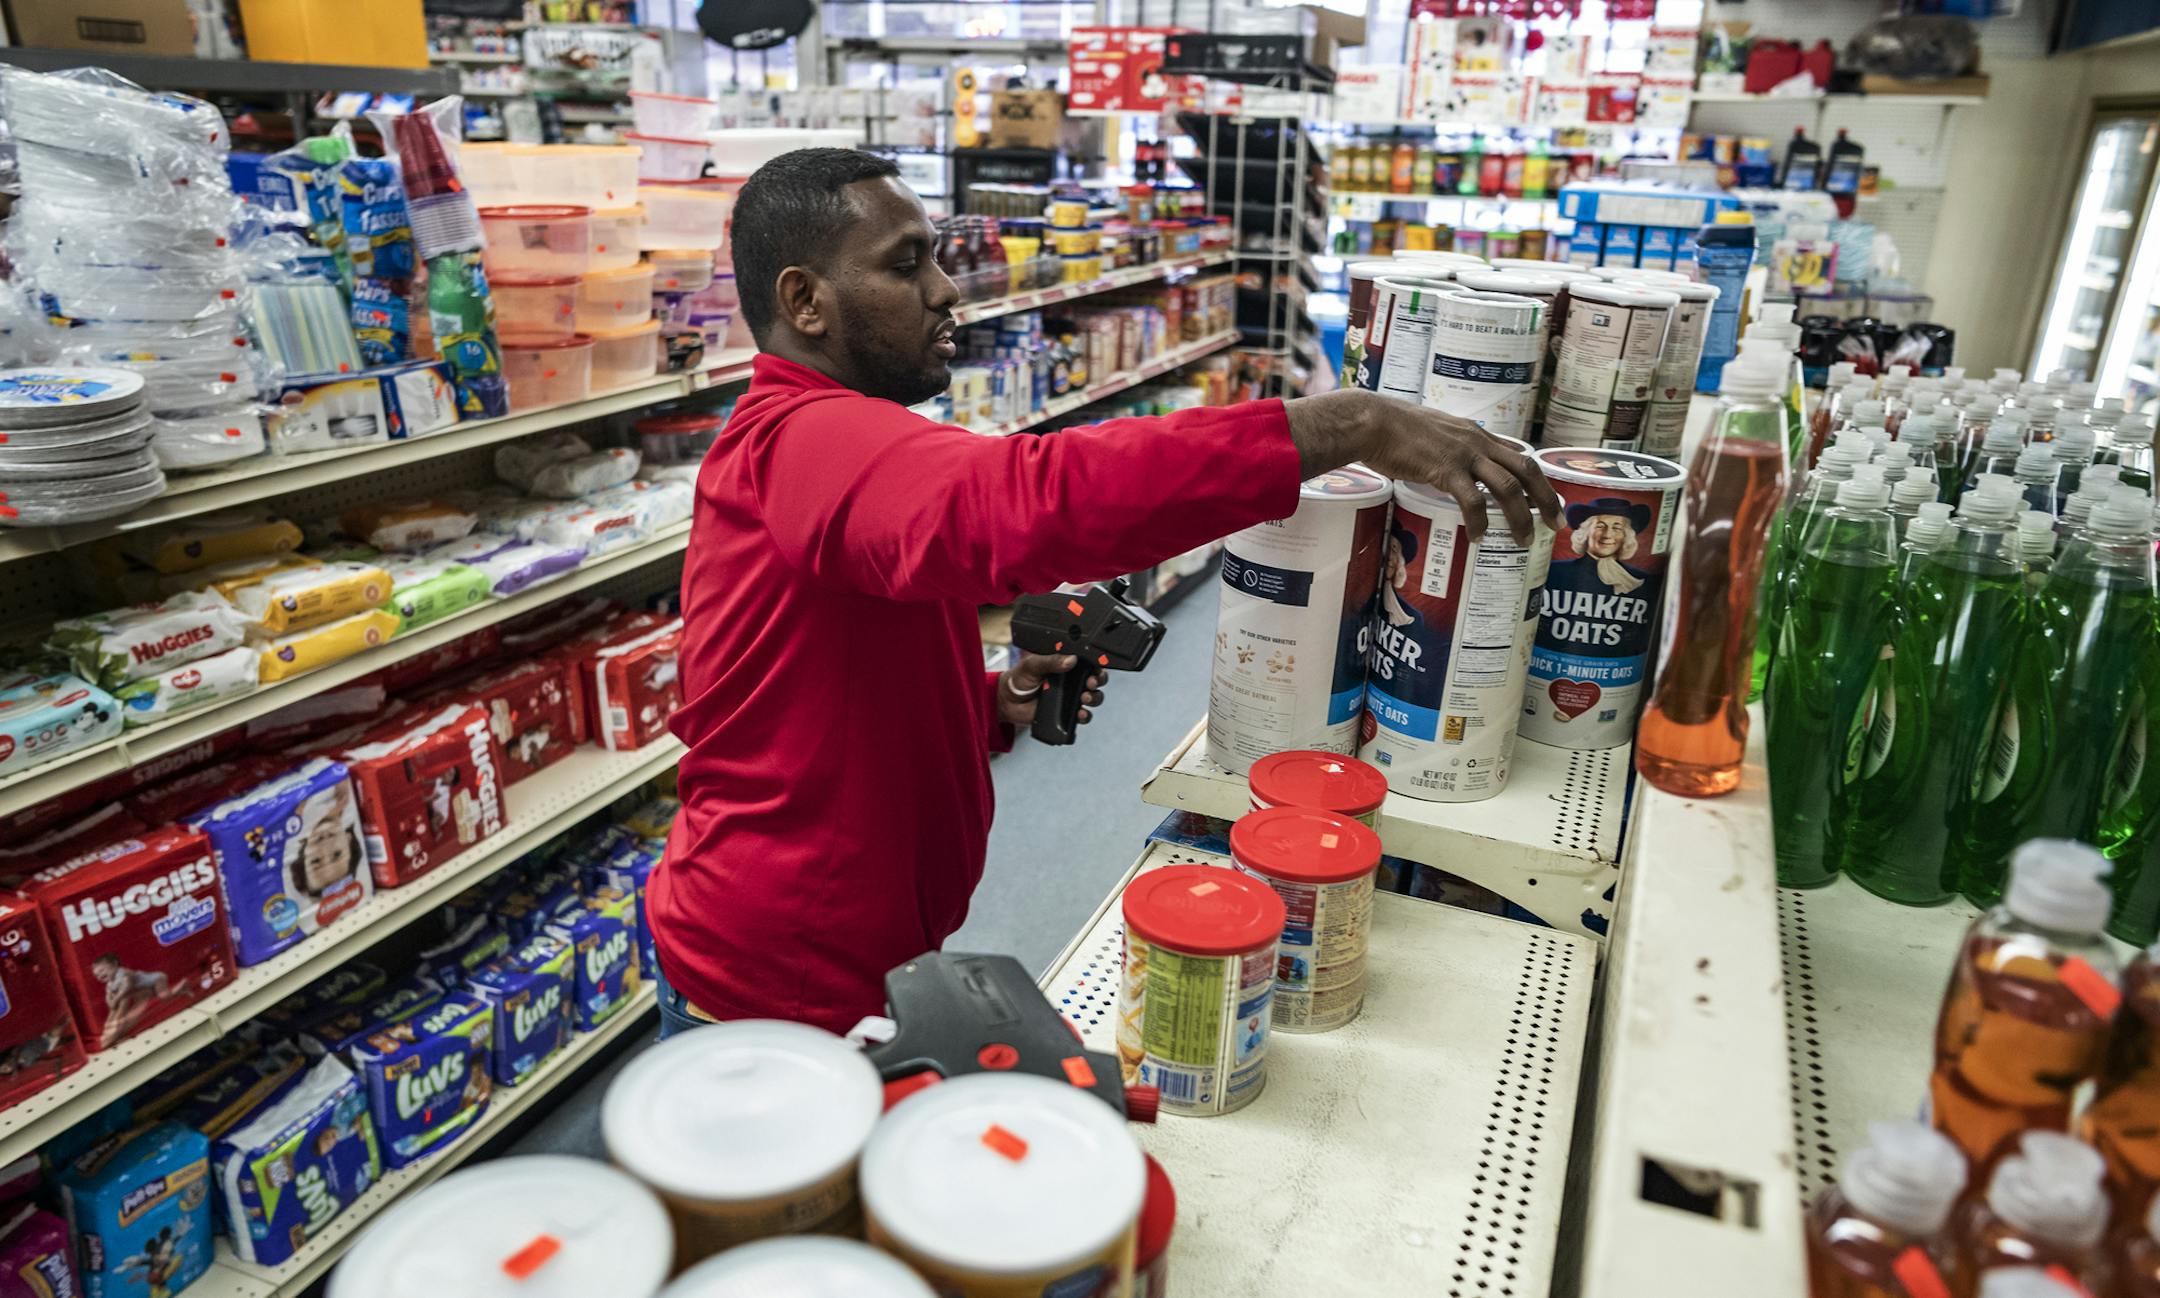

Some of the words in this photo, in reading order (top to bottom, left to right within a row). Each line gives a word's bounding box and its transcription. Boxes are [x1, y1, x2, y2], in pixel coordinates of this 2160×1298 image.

[1449, 320, 1464, 330] HARD
[1465, 323, 1474, 332] TO
[1475, 324, 1493, 334] BEAT
[1477, 557, 1501, 565] Calories
[1516, 555, 1528, 565] 150
[1540, 588, 1648, 624] QUAKER
[131, 624, 214, 665] HUGGIES
[1551, 616, 1622, 646] OATS
[1530, 656, 1553, 672] UICK
[1556, 662, 1609, 679] 1-MINUTE
[1611, 665, 1633, 679] OATS
[1385, 706, 1409, 726] OATS
[1423, 769, 1433, 779] NET
[62, 854, 217, 943] HUGGIES
[154, 899, 214, 936] movers
[211, 960, 225, 979] 5
[586, 930, 629, 985] Luvs
[514, 985, 561, 1044] Luvs
[396, 1050, 466, 1121] Luvs
